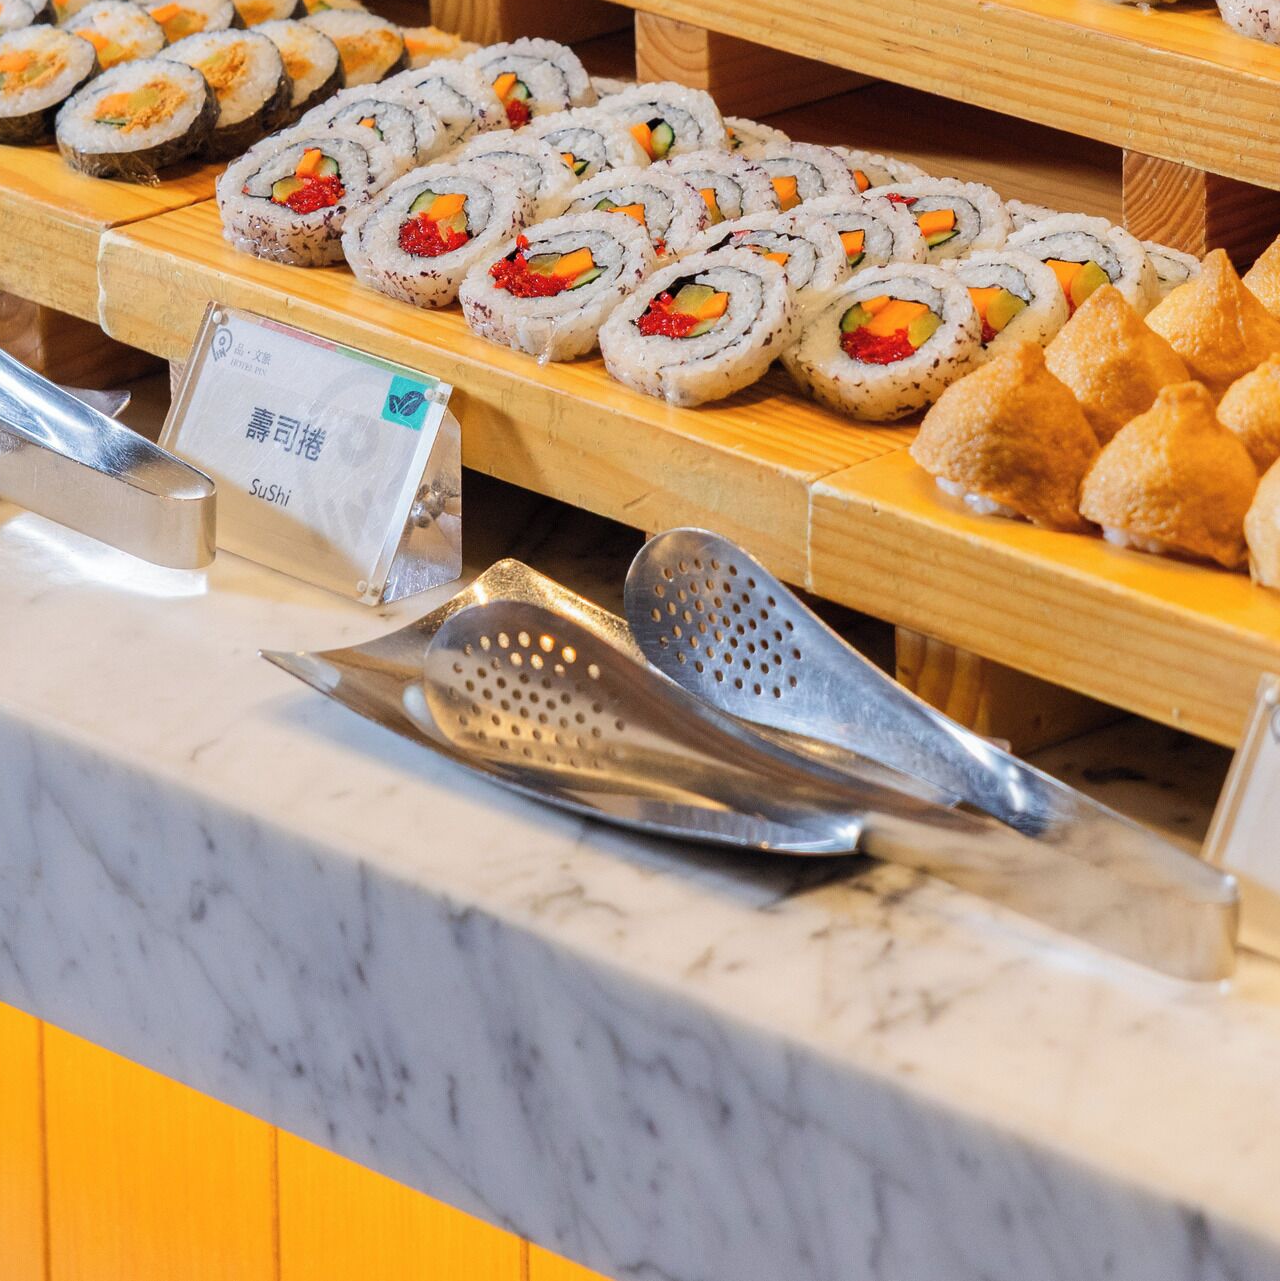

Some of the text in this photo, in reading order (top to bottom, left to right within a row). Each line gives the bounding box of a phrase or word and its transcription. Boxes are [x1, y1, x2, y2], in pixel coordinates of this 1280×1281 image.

[245, 406, 327, 461] 壽司捲
[248, 478, 292, 507] SuShi
